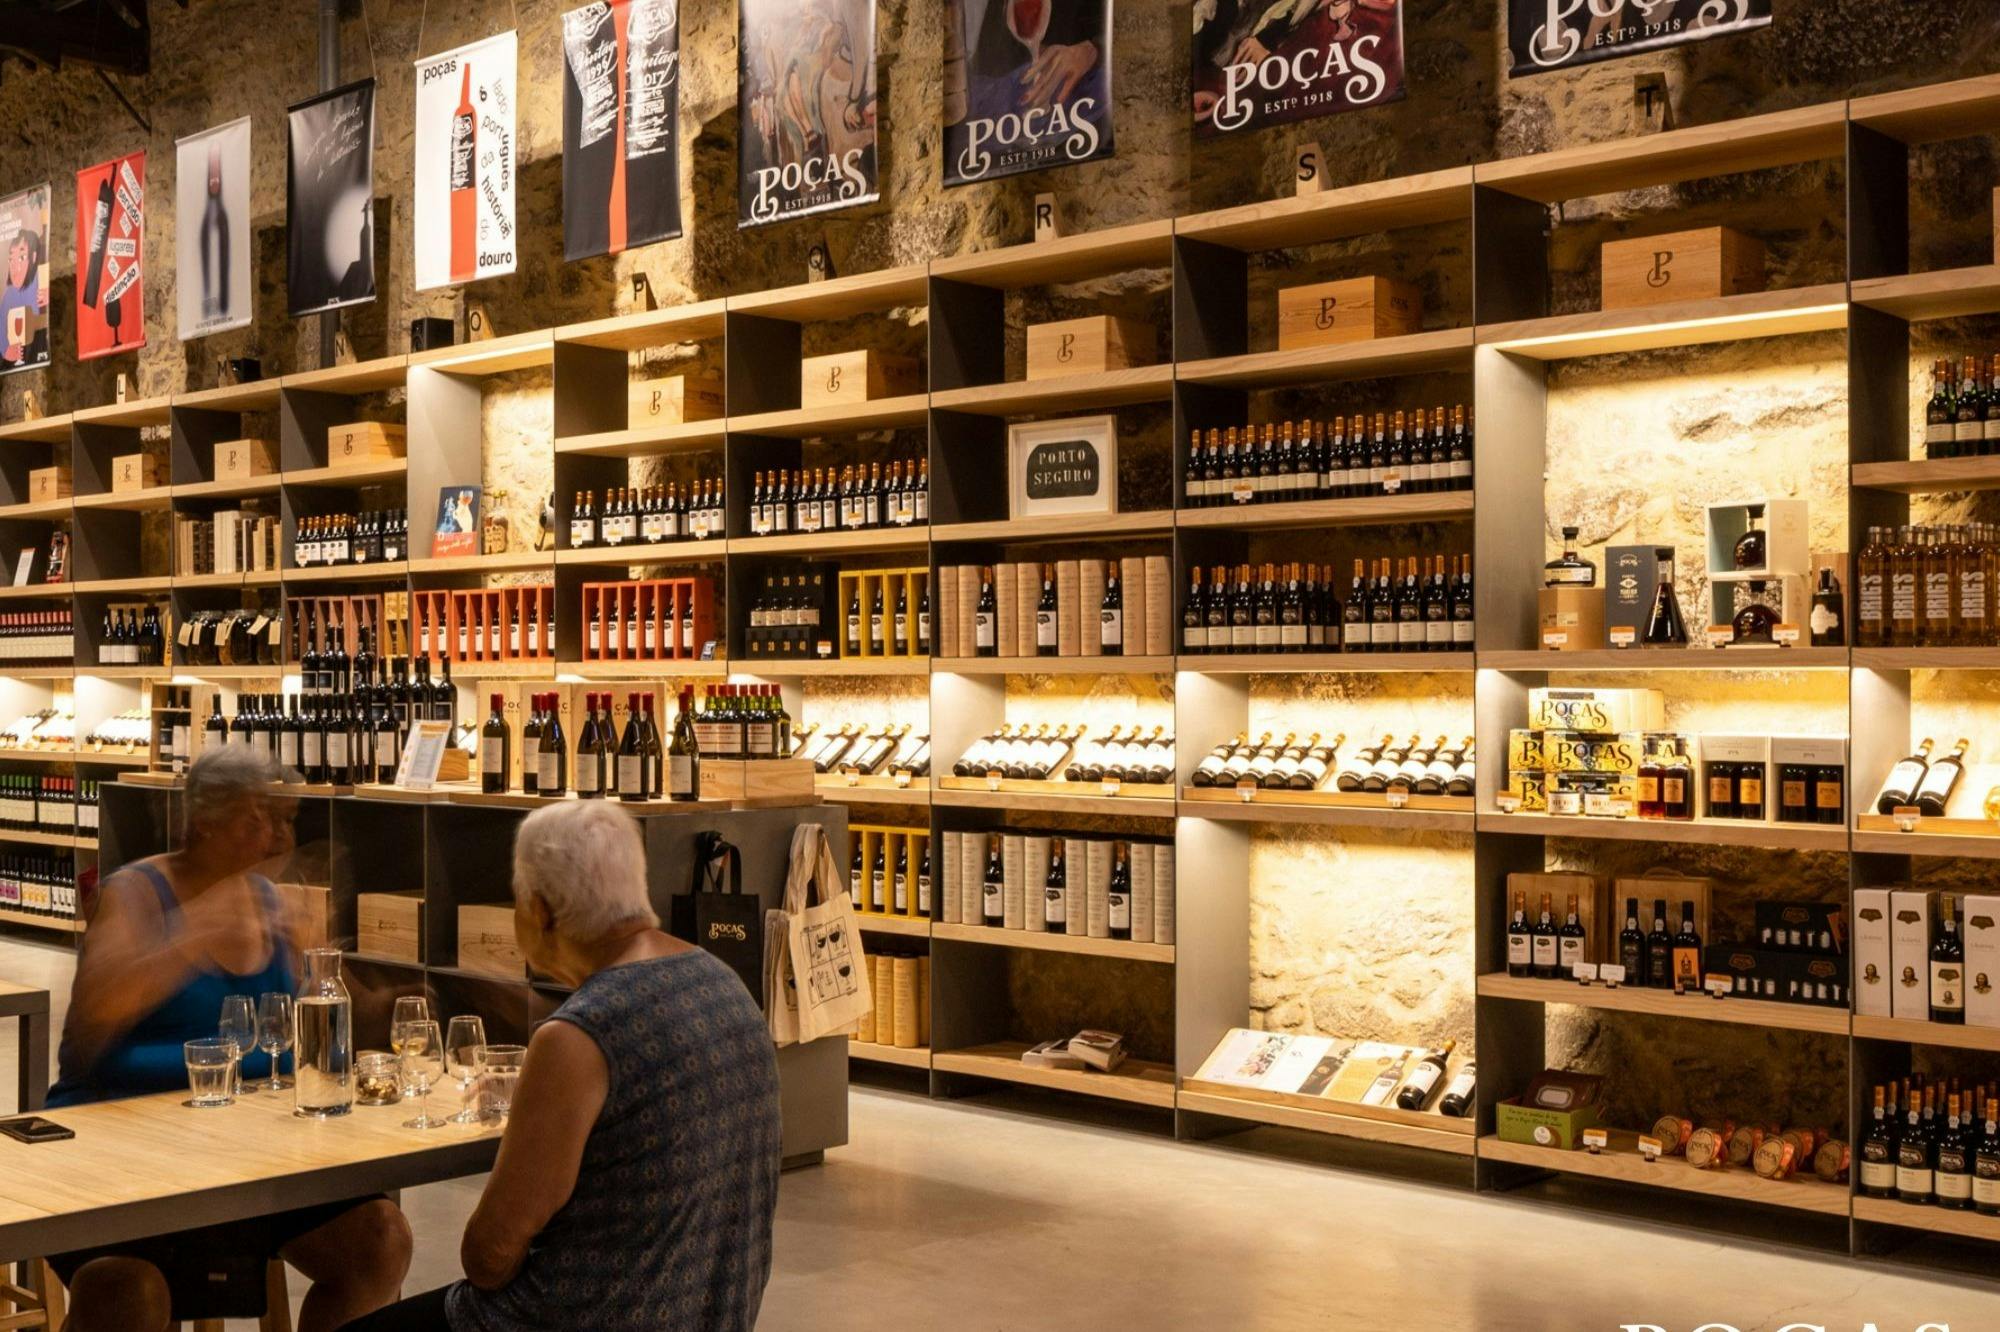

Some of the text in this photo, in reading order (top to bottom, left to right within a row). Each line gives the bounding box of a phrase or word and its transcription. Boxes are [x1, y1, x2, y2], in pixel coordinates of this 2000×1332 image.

[1645, 18, 1682, 36] 1918
[423, 58, 457, 84] poças
[1213, 35, 1385, 131] POÇAS
[1303, 91, 1333, 107] 1918
[1638, 85, 1660, 117] T
[958, 98, 1099, 180] POÇAS
[1032, 146, 1056, 160] 1918
[1299, 153, 1316, 181] S
[751, 148, 867, 222] POÇAS
[118, 187, 140, 224] servido
[1037, 203, 1052, 229] R
[479, 251, 512, 268] douro
[105, 266, 137, 302] distinção
[634, 280, 644, 301] P
[335, 339, 345, 357] N
[1039, 449, 1086, 466] PORTO
[1033, 469, 1092, 486] SEGURO
[709, 922, 746, 940] POÇAS
